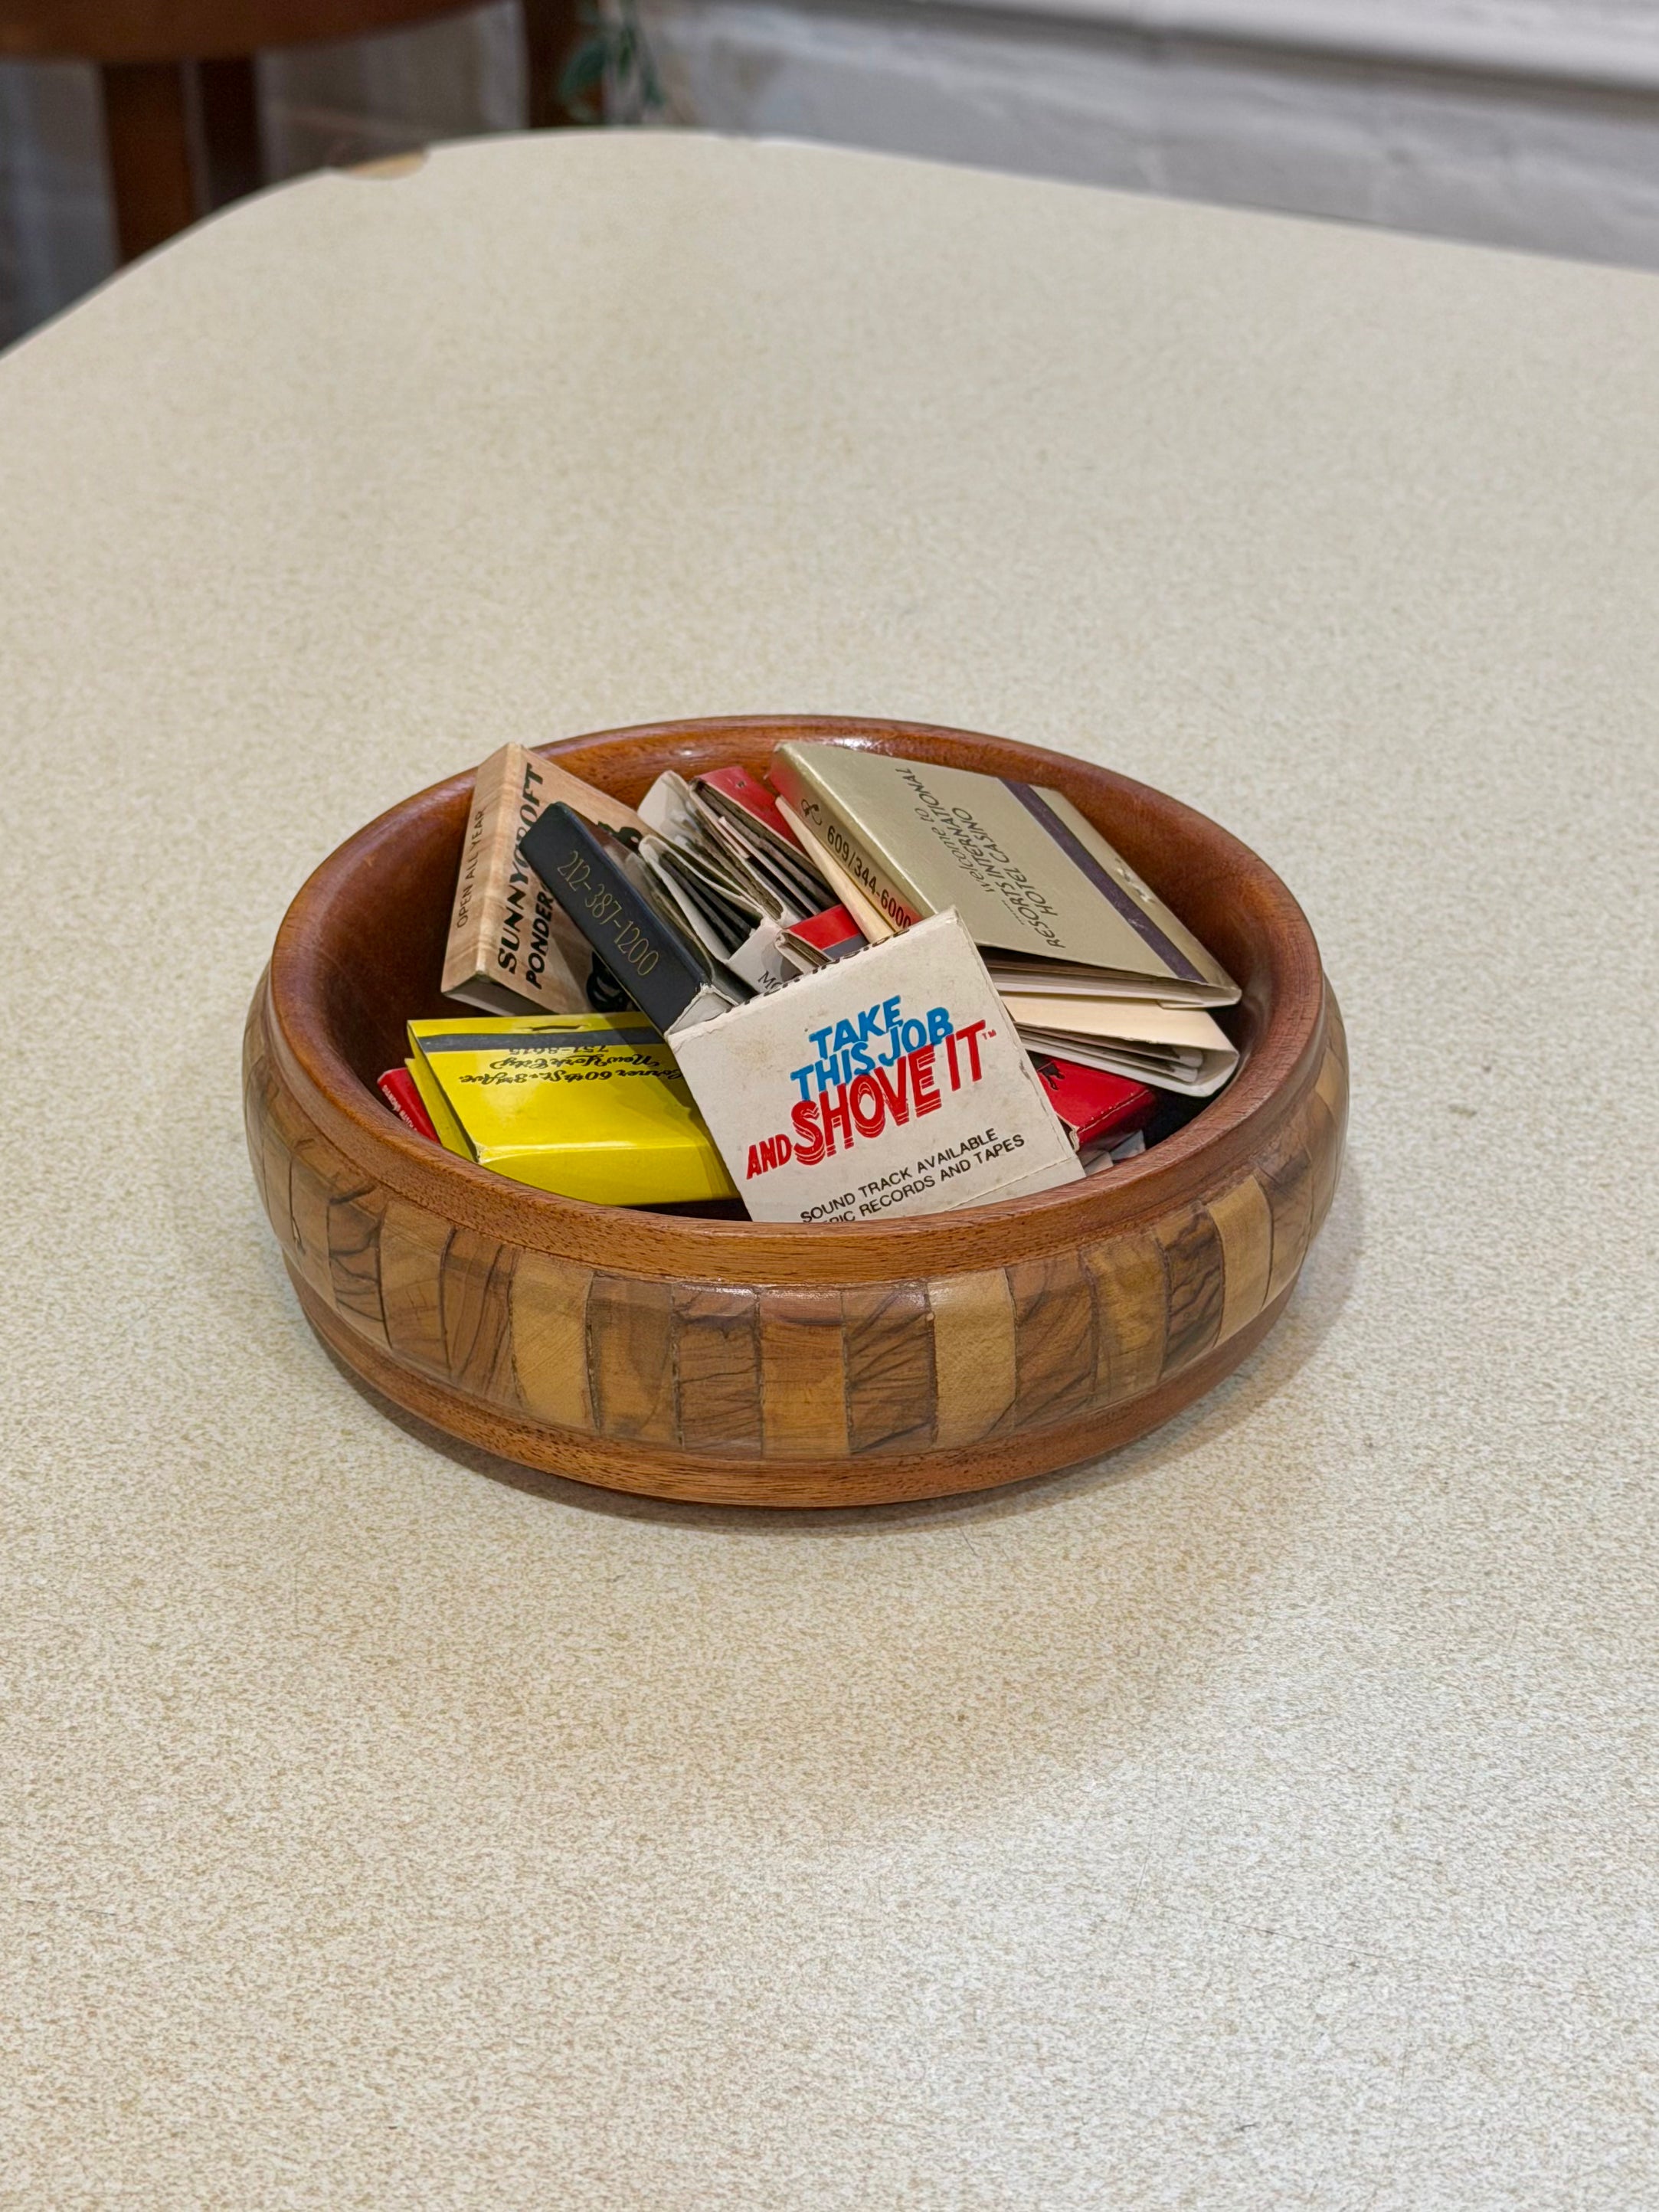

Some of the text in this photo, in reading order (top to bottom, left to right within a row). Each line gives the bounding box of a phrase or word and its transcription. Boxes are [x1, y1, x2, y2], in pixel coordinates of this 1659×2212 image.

[456, 810, 484, 929] OPEN ALL YEAR
[895, 768, 1066, 948] RESORTS INTERNATIONAL
[914, 808, 995, 892] welcome to
[951, 807, 1059, 916] HOTEL CASINO
[557, 850, 659, 977] 212-387-1200
[489, 1053, 659, 1070] New York City
[790, 1006, 954, 1101] THIS JOB
[808, 995, 904, 1059] TAKE
[564, 1071, 612, 1083] 60th
[745, 1134, 793, 1180] AND
[791, 1044, 942, 1166] SHOVE
[800, 1127, 999, 1223] SOUND TRACK AVAILABLE
[859, 1174, 936, 1217] RECORDS
[941, 1159, 971, 1183] AND
[973, 1134, 1025, 1164] TAPES
